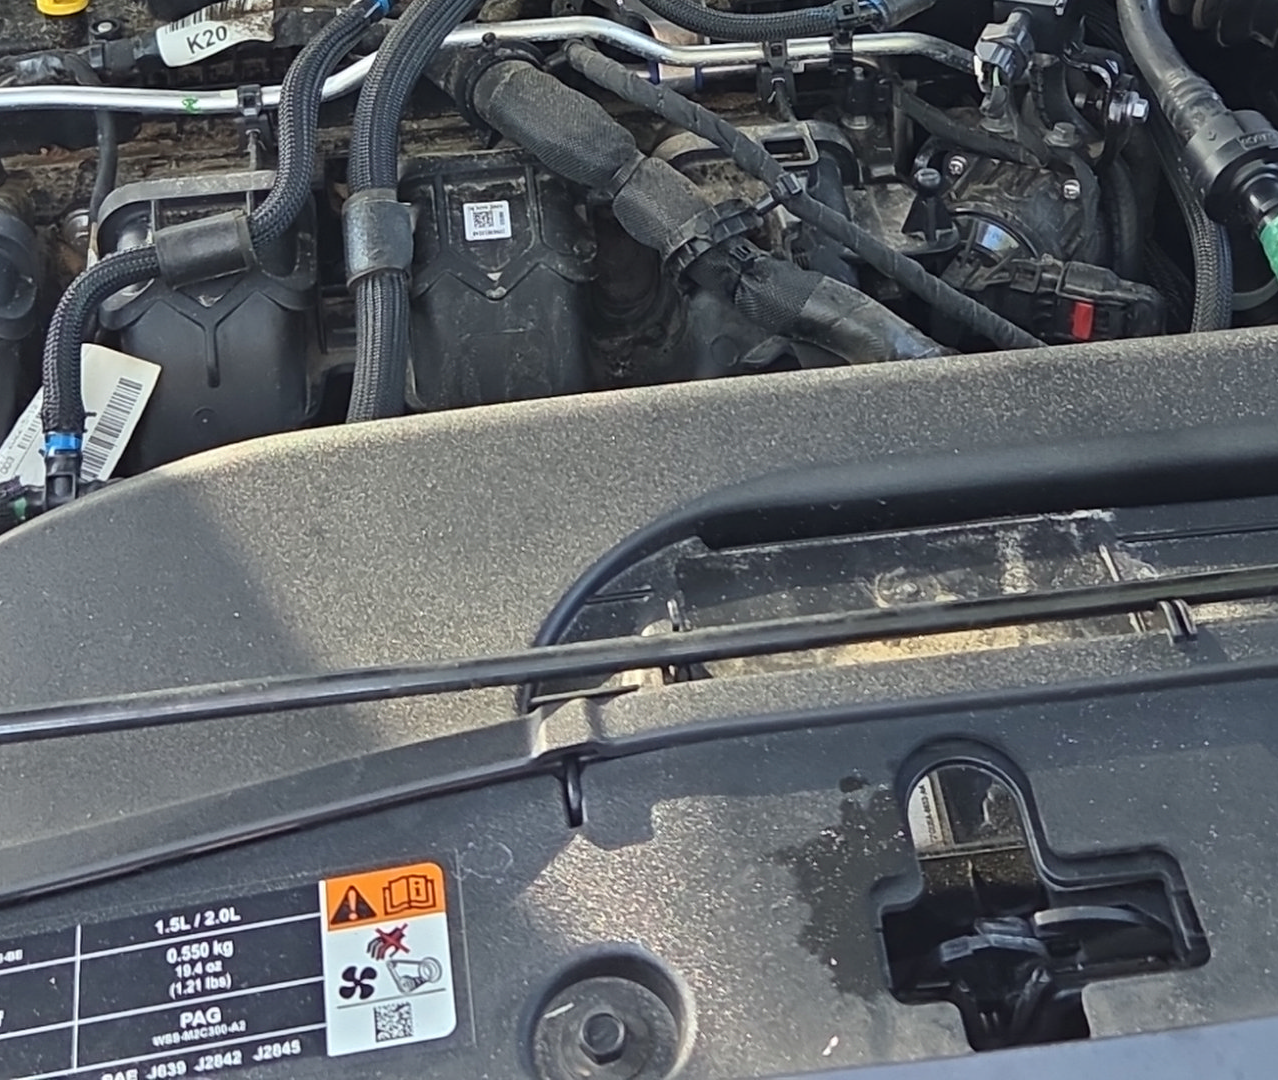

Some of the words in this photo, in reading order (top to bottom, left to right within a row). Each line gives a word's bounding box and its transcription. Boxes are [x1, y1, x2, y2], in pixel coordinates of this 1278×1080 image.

[186, 25, 228, 54] K20
[154, 918, 191, 935] 1.5L
[194, 913, 201, 928] /
[204, 907, 242, 926] 2.0L
[166, 942, 210, 964] 0.550
[212, 939, 234, 958] kg
[174, 963, 203, 979] 19.4
[205, 960, 222, 974] oz
[168, 979, 202, 1000] (1.21
[205, 972, 232, 990] lbs)
[179, 1006, 222, 1029] PAG
[145, 1060, 187, 1080] J639
[193, 1050, 243, 1072] J2842
[252, 1039, 302, 1062] J2845
